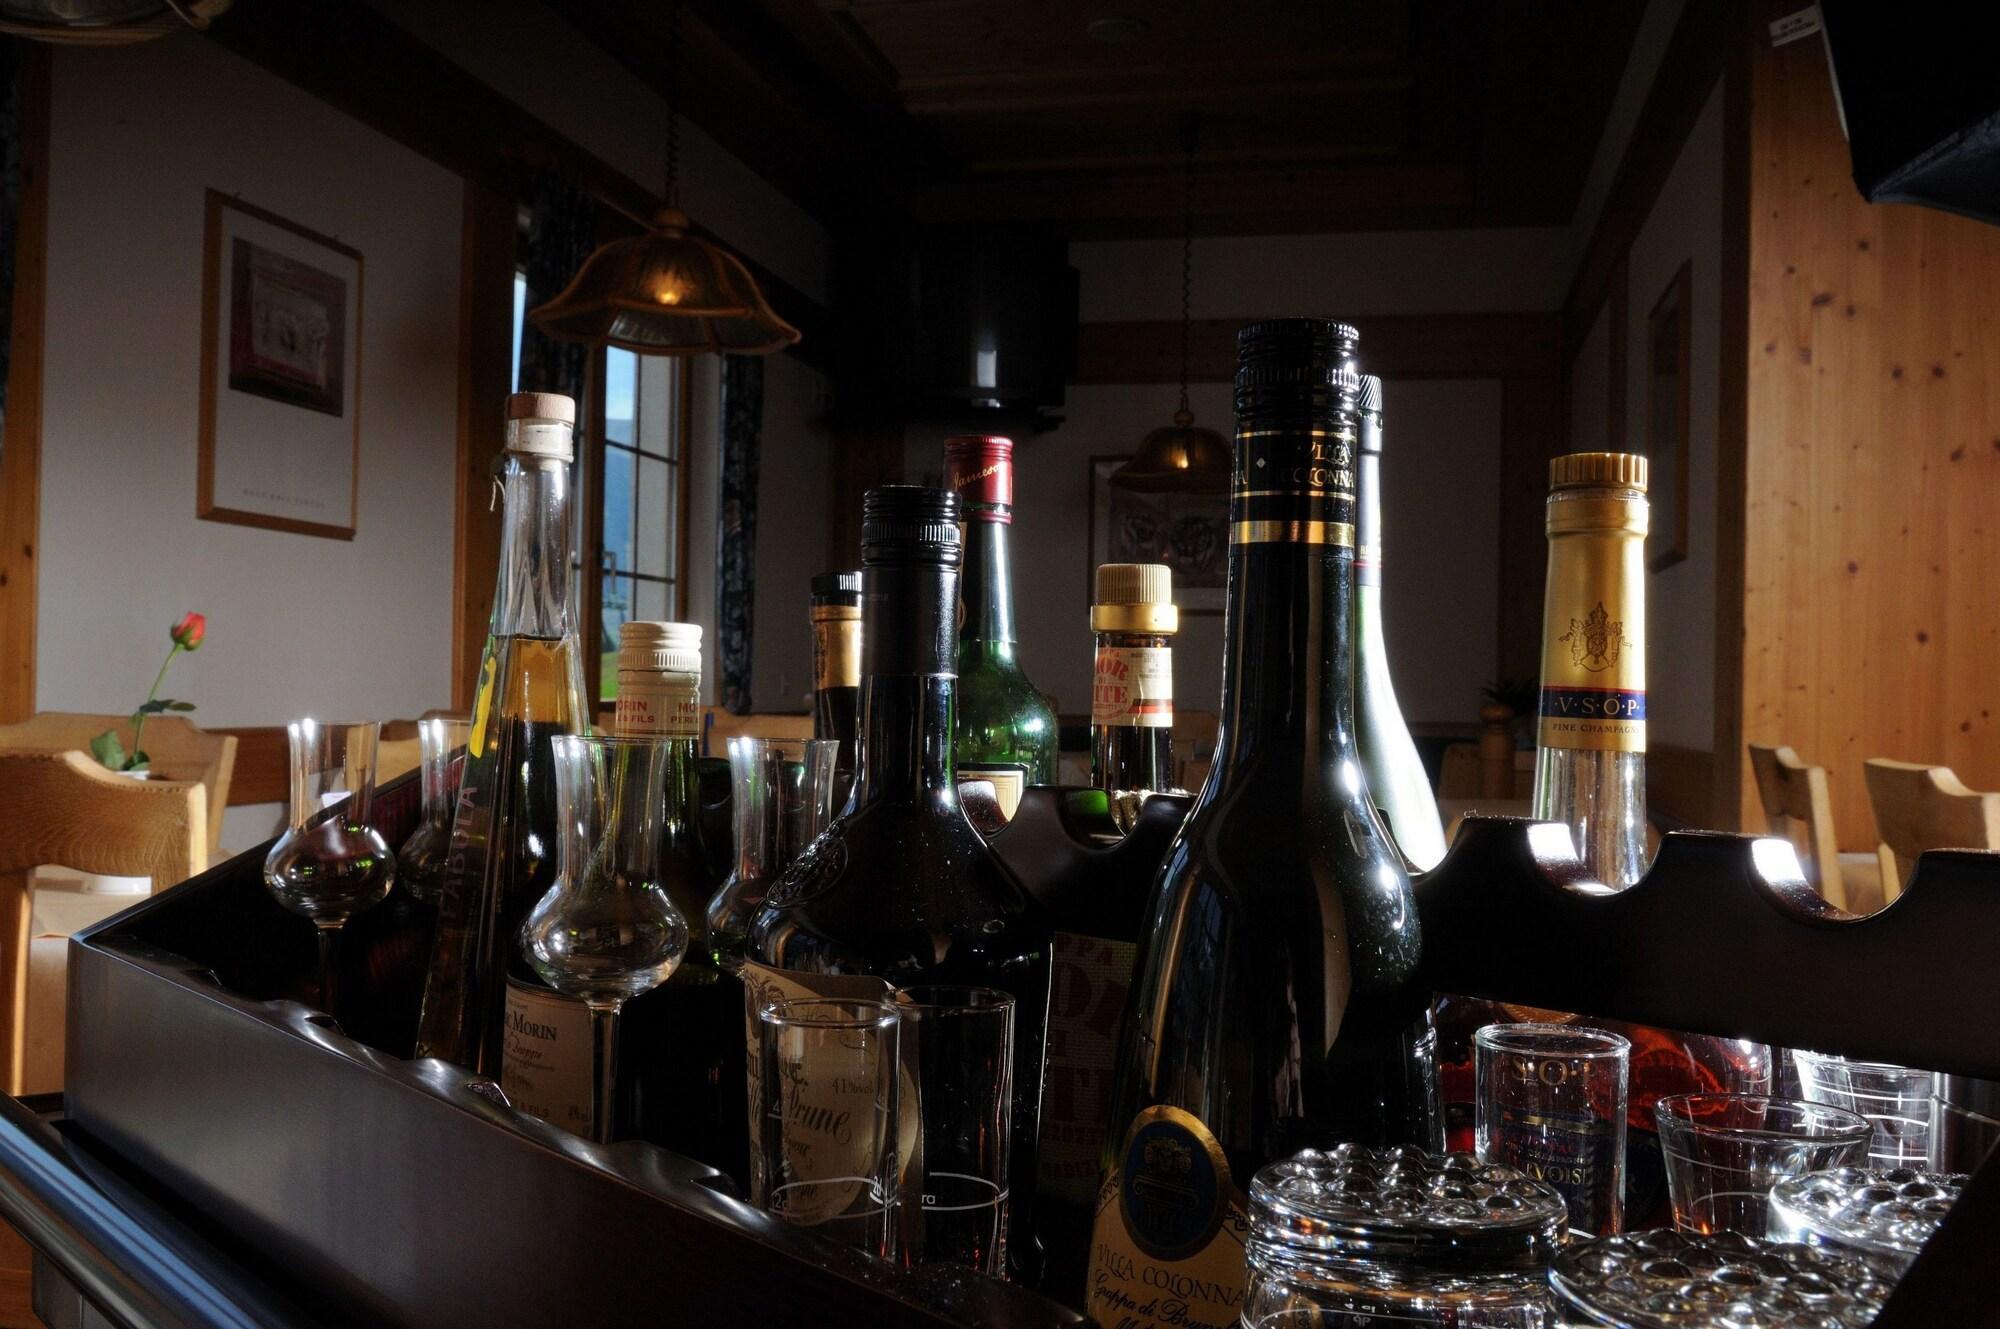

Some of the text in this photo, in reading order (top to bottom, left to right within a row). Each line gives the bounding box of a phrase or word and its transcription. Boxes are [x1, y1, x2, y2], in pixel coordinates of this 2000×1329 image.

[631, 715, 655, 723] FILS
[1553, 723, 1576, 732] FINE
[1139, 1298, 1158, 1318] di
